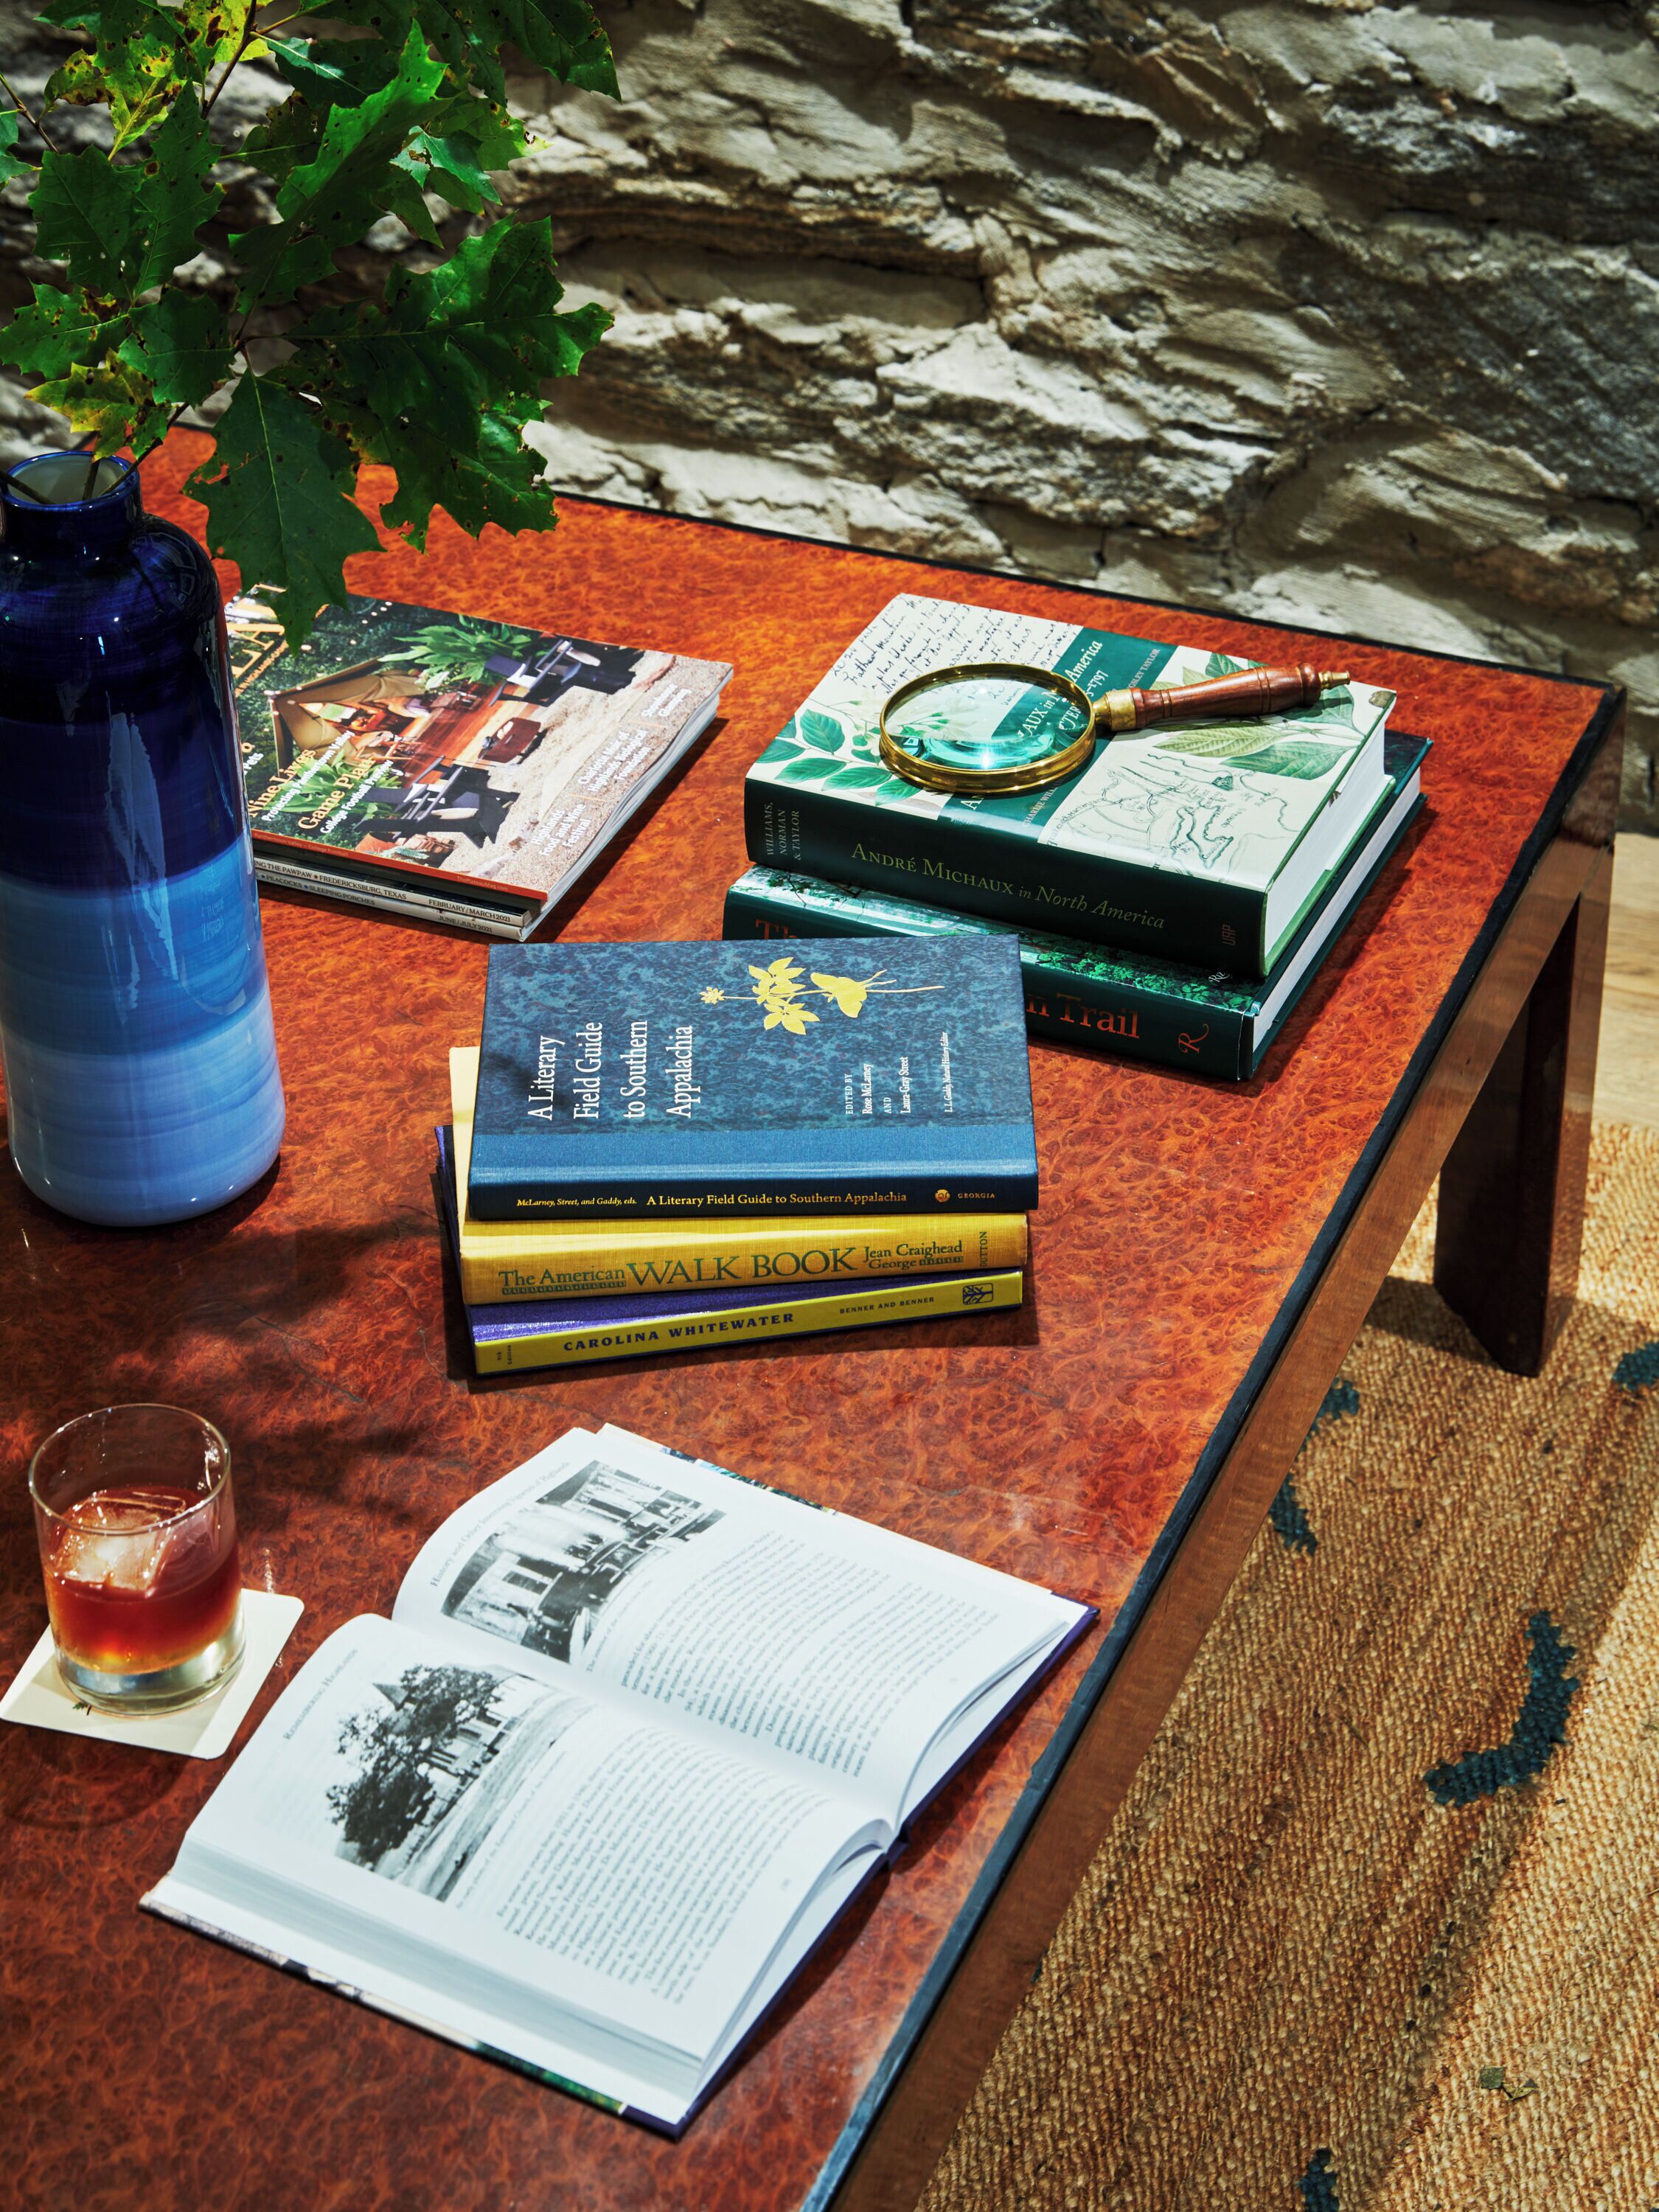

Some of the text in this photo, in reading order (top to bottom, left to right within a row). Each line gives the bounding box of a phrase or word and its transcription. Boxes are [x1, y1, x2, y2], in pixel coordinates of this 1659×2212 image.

[1064, 639, 1103, 684] America
[1142, 648, 1161, 672] TAYLOR
[261, 730, 355, 822] Protecting Panthertown Valley
[578, 754, 608, 785] Charlotte
[618, 730, 630, 744] of
[588, 729, 649, 793] Highlands Biological
[614, 745, 652, 781] Foundation
[248, 785, 281, 818] Nine
[269, 749, 316, 784] Lives
[298, 790, 346, 830] Game
[333, 755, 377, 790] Plan
[320, 759, 394, 834] College Football Preview
[531, 809, 566, 846] Highlands
[538, 803, 586, 857] Food and Wine
[563, 818, 591, 847] Festival
[764, 801, 773, 856] WILLIAMS,
[779, 808, 787, 856] NORMAN
[793, 810, 801, 860] & TAYLOR
[266, 863, 282, 872] THE
[282, 866, 313, 879] PAWPAW
[266, 874, 302, 888] PEACOCKS
[319, 874, 406, 900] FREDERICKSBURG, TEXAS
[850, 842, 1166, 930] ANDRÉ MICHAUX in North America
[309, 884, 375, 905] SLEEPING PORCHES
[428, 899, 466, 913] FEBRUARY
[469, 908, 495, 920] MARCH
[495, 914, 511, 922] 2021
[438, 915, 456, 925] JUNE
[460, 920, 479, 929] JULY
[478, 924, 493, 933] 2021
[1055, 992, 1141, 1040] Trail
[940, 1032, 949, 1046] Editor
[941, 1047, 951, 1065] History
[527, 1034, 566, 1121] A Literary
[573, 1021, 603, 1119] Field Guide
[619, 1020, 648, 1119] to Southern
[665, 1025, 701, 1119] Appalachia
[860, 1062, 874, 1115] Rose McLarney
[898, 1056, 913, 1114] Laura-Gray Street
[942, 1065, 951, 1083] Natural
[844, 1073, 854, 1115] EDITED BY
[883, 1096, 892, 1114] AND
[942, 1083, 954, 1101] Gaddy,
[516, 1197, 637, 1208] McLarney, Street, and Gaddy, eds.
[647, 1192, 908, 1208] A Literary Field Guide to Southern Appalachia
[499, 1247, 859, 1287] The American WALK BOOK
[863, 1239, 963, 1263] Jean Craighead
[869, 1257, 917, 1270] George
[979, 1231, 988, 1268] DUTTON
[839, 1296, 935, 1314] BENNER AND BENNER
[563, 1312, 794, 1352] CAROLINA WHITEWATER
[431, 1558, 456, 1587] History
